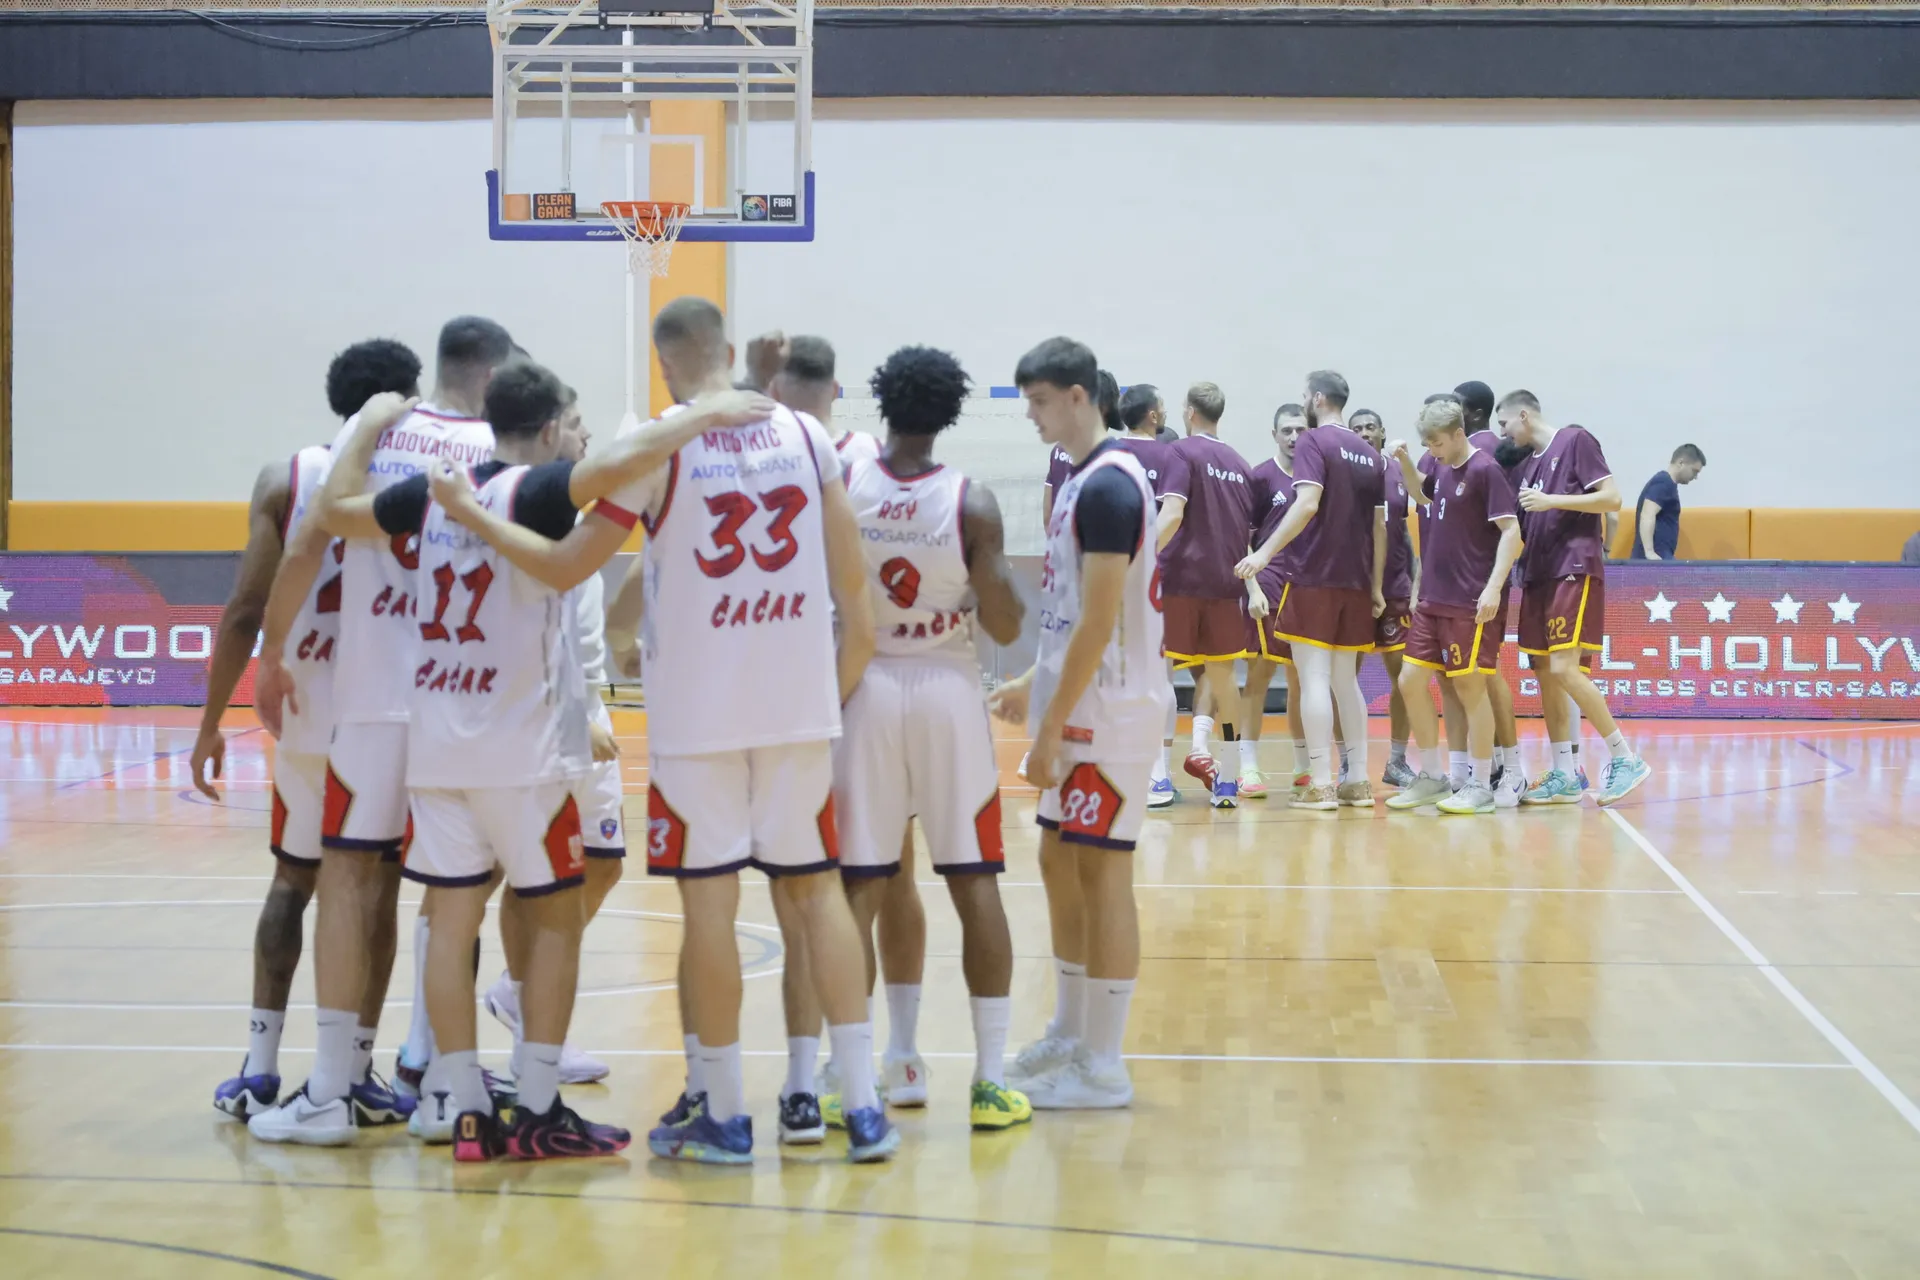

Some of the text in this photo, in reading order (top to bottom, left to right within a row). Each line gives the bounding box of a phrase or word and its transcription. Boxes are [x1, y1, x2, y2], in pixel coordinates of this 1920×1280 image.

[537, 194, 572, 207] CLEAN
[773, 197, 792, 208] FIBA
[538, 206, 572, 219] GAME
[1341, 447, 1374, 467] bosna
[1207, 463, 1244, 484] bosna
[1438, 498, 1446, 521] 3
[694, 485, 808, 579] 33
[420, 560, 493, 644] 11
[1548, 616, 1567, 641] 22
[0, 625, 264, 659] YWOO
[1452, 643, 1463, 666] 3
[1062, 788, 1102, 827] 88
